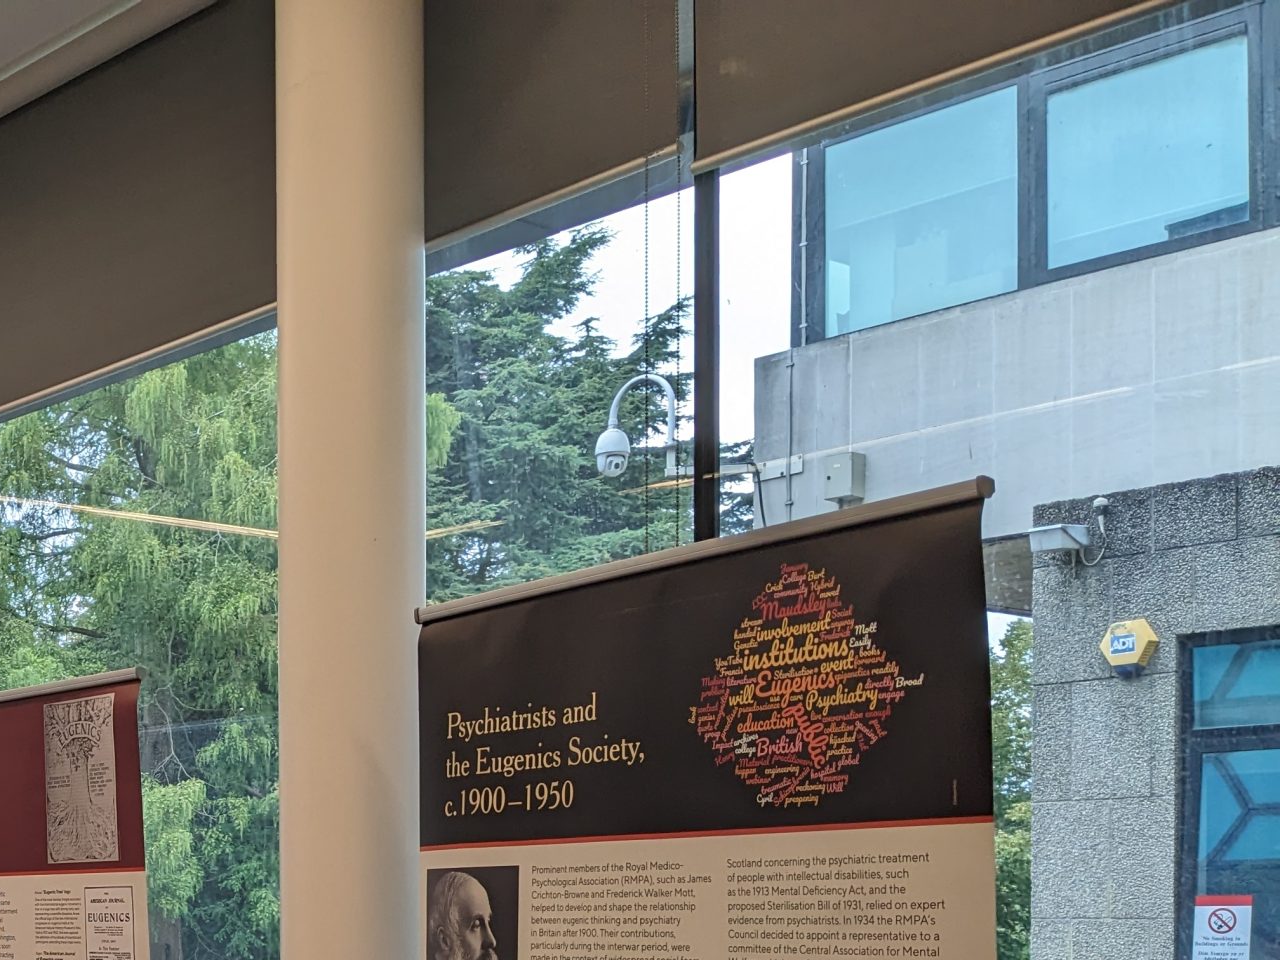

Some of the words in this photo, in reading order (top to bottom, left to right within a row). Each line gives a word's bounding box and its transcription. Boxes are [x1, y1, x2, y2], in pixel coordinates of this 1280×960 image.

[808, 568, 825, 581] Burt
[761, 593, 827, 620] Maudsley
[757, 611, 831, 641] involvement
[855, 622, 877, 635] Mott
[743, 633, 849, 670] institutions
[849, 634, 871, 649] Easily
[859, 645, 880, 657] books
[1110, 637, 1135, 650] ADT
[821, 650, 854, 672] event
[755, 670, 836, 708] Eugenics
[895, 673, 924, 688] Broad
[729, 684, 755, 706] will
[806, 683, 878, 715] Psychiatry
[447, 703, 556, 742] Psychiatrists
[563, 692, 597, 725] and
[737, 711, 794, 733] education
[59, 723, 100, 748] EUGENICS
[756, 732, 802, 757] British
[782, 703, 828, 768] Public
[446, 751, 470, 778] the
[476, 742, 561, 777] Eugenics
[568, 734, 645, 766] Society,
[757, 792, 773, 807] Cyril
[532, 865, 567, 874] Prominent
[568, 864, 600, 873] members
[601, 864, 607, 872] of
[611, 863, 624, 872] the
[625, 863, 648, 873] Royal
[650, 862, 684, 871] Medico-
[727, 858, 762, 868] Scotland
[763, 857, 811, 868] concerning
[812, 856, 827, 866] the
[828, 854, 876, 868] psychiatric
[878, 853, 930, 864] treatment
[737, 887, 751, 896] the
[752, 887, 769, 896] 1913
[771, 886, 801, 896] Mental
[802, 886, 847, 898] Deficiency
[848, 885, 867, 896] Act,
[868, 885, 887, 895] and
[889, 885, 906, 894] the
[88, 913, 130, 922] EUGENICS
